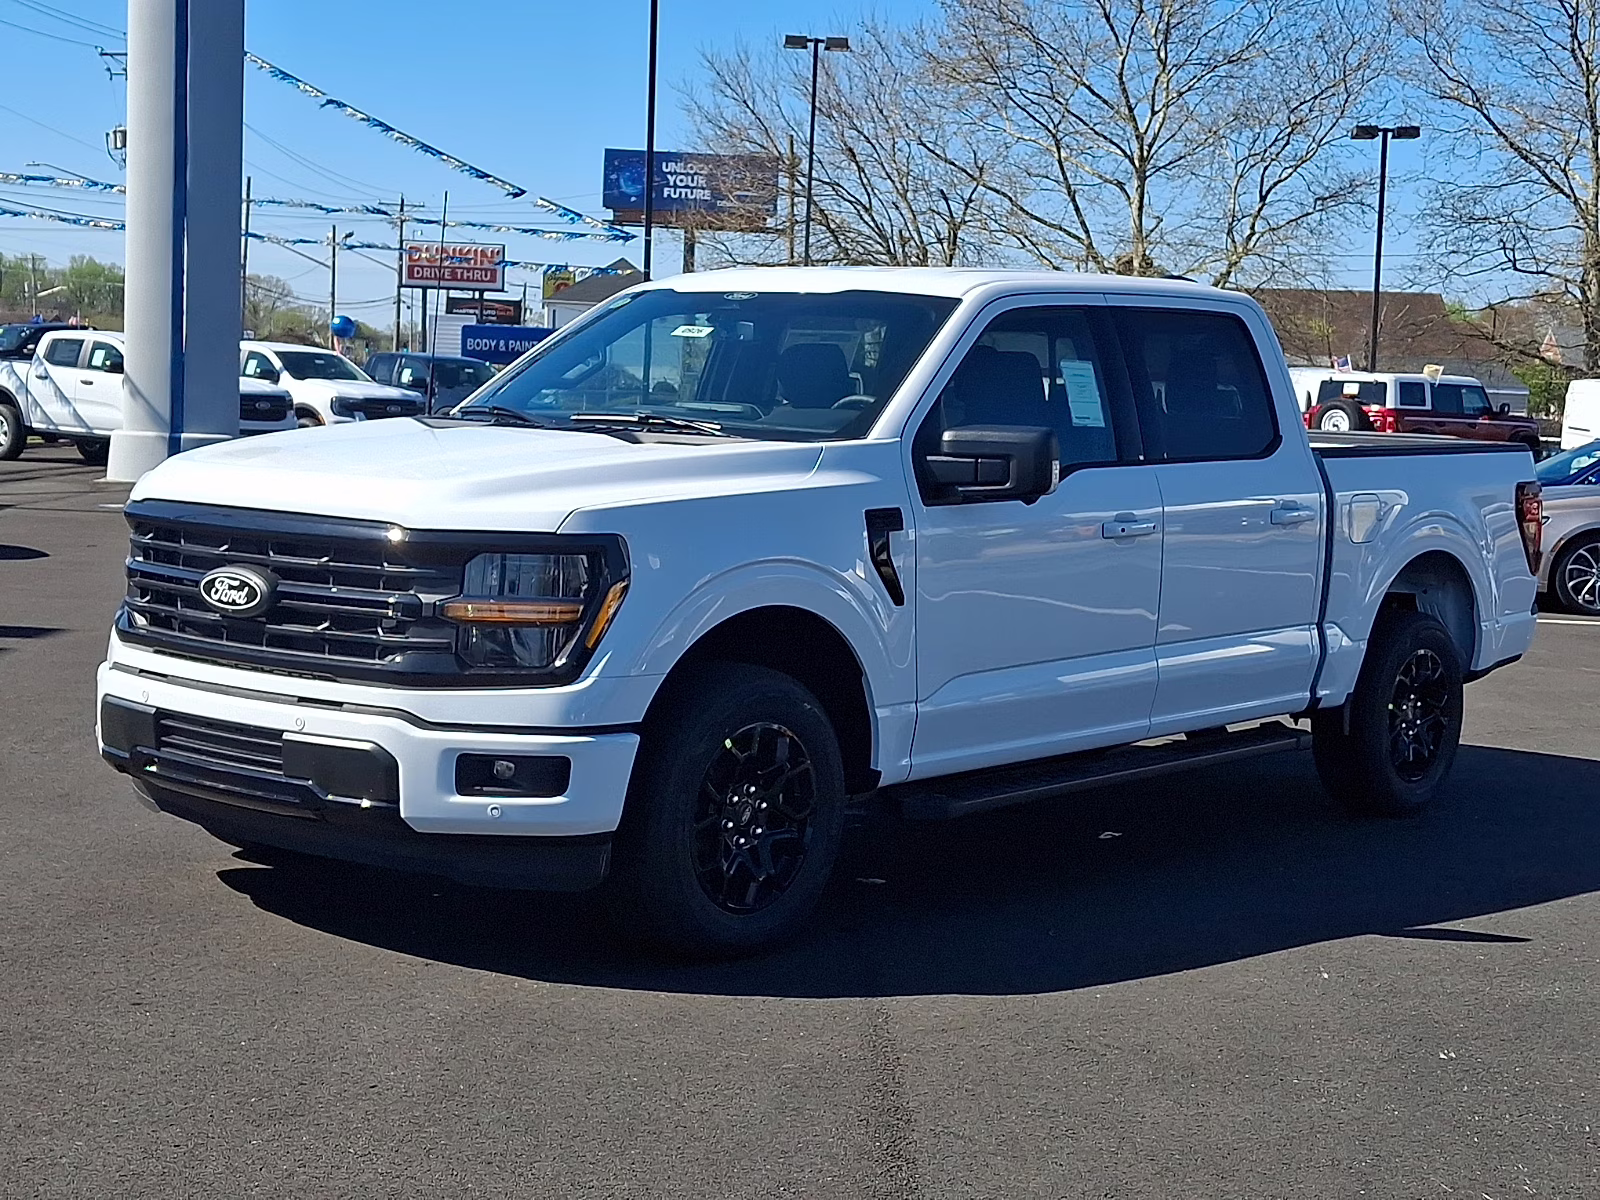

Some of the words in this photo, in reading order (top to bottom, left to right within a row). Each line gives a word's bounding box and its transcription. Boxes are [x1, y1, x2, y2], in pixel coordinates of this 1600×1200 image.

[662, 161, 711, 174] UNLOC
[666, 174, 707, 187] YOUR
[663, 187, 711, 200] FUTURE
[407, 244, 500, 266] DUNKIN'
[413, 266, 452, 279] DRIVE
[455, 269, 491, 281] THRU
[466, 338, 497, 351] BODY
[498, 339, 507, 352] &
[210, 576, 249, 605] Ford
